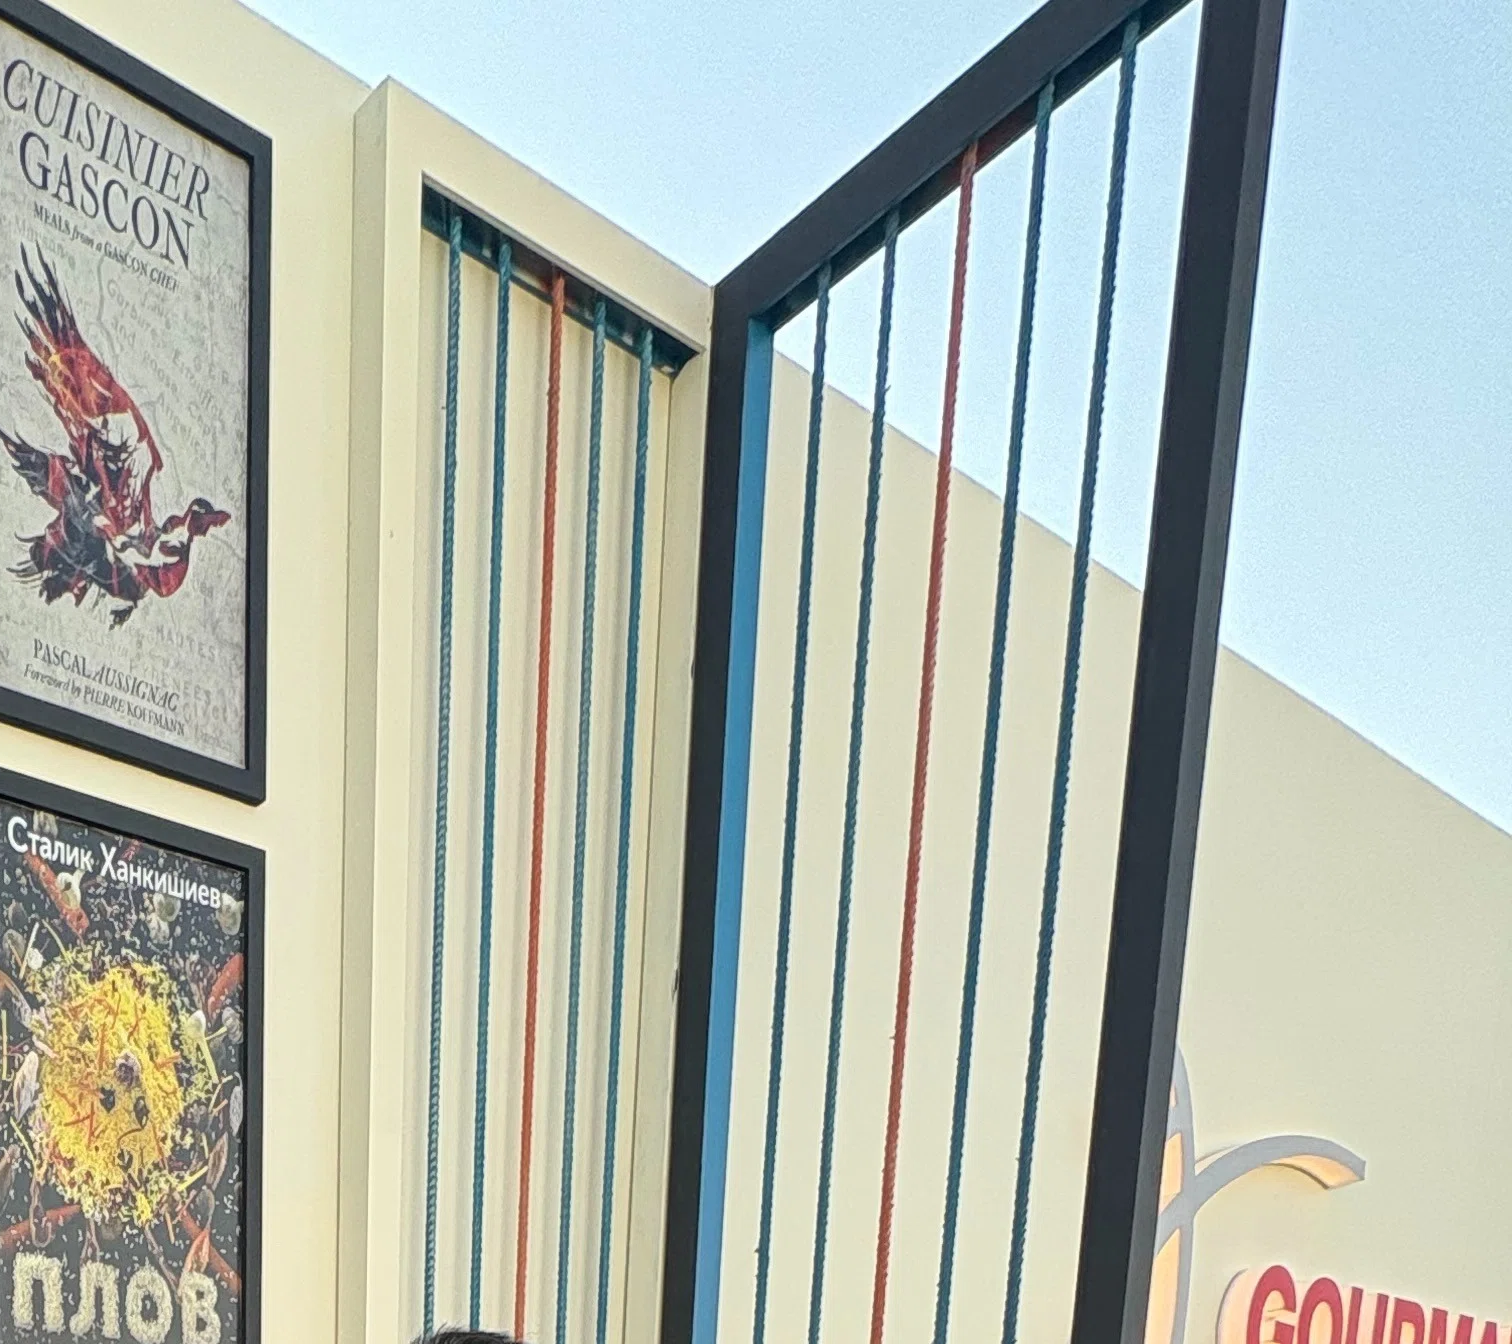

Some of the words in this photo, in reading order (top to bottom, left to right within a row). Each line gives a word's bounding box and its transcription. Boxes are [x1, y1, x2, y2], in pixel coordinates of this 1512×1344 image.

[3, 59, 210, 221] CUISINIER
[19, 131, 194, 271] GASCON
[34, 201, 71, 236] MEALS
[71, 225, 94, 250] from
[104, 240, 149, 277] GASCON
[24, 663, 70, 691] Foreword
[83, 684, 126, 713] PIERRE
[127, 701, 185, 737] KOFFMANN
[33, 638, 92, 679] PASCAL
[92, 663, 180, 713] AUSSIGNAC
[7, 816, 93, 873] Сталик
[100, 842, 221, 908] Ханкишиев
